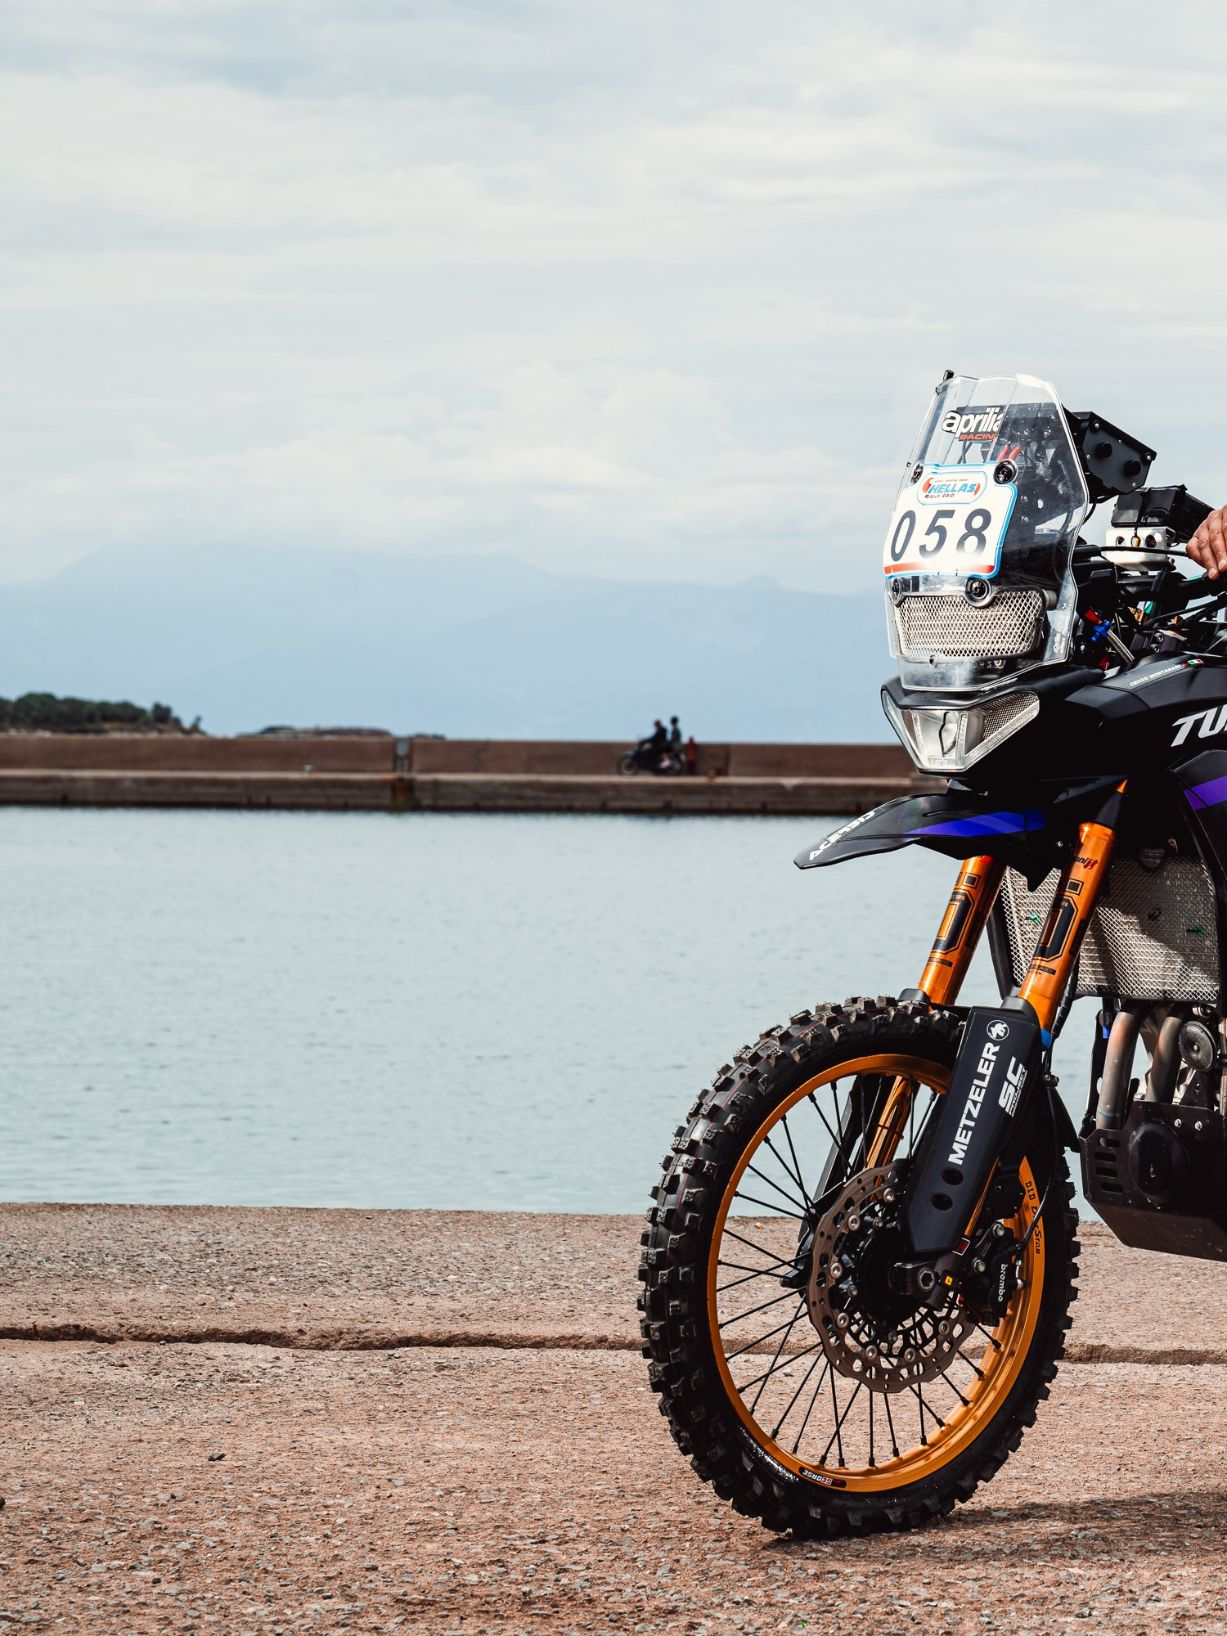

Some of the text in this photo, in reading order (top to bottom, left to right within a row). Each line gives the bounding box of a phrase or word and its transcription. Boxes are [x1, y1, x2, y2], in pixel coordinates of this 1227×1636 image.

[928, 483, 976, 494] HELLAS
[891, 508, 992, 561] 058
[948, 1042, 1001, 1166] METZELER
[998, 1263, 1008, 1302] brembo
